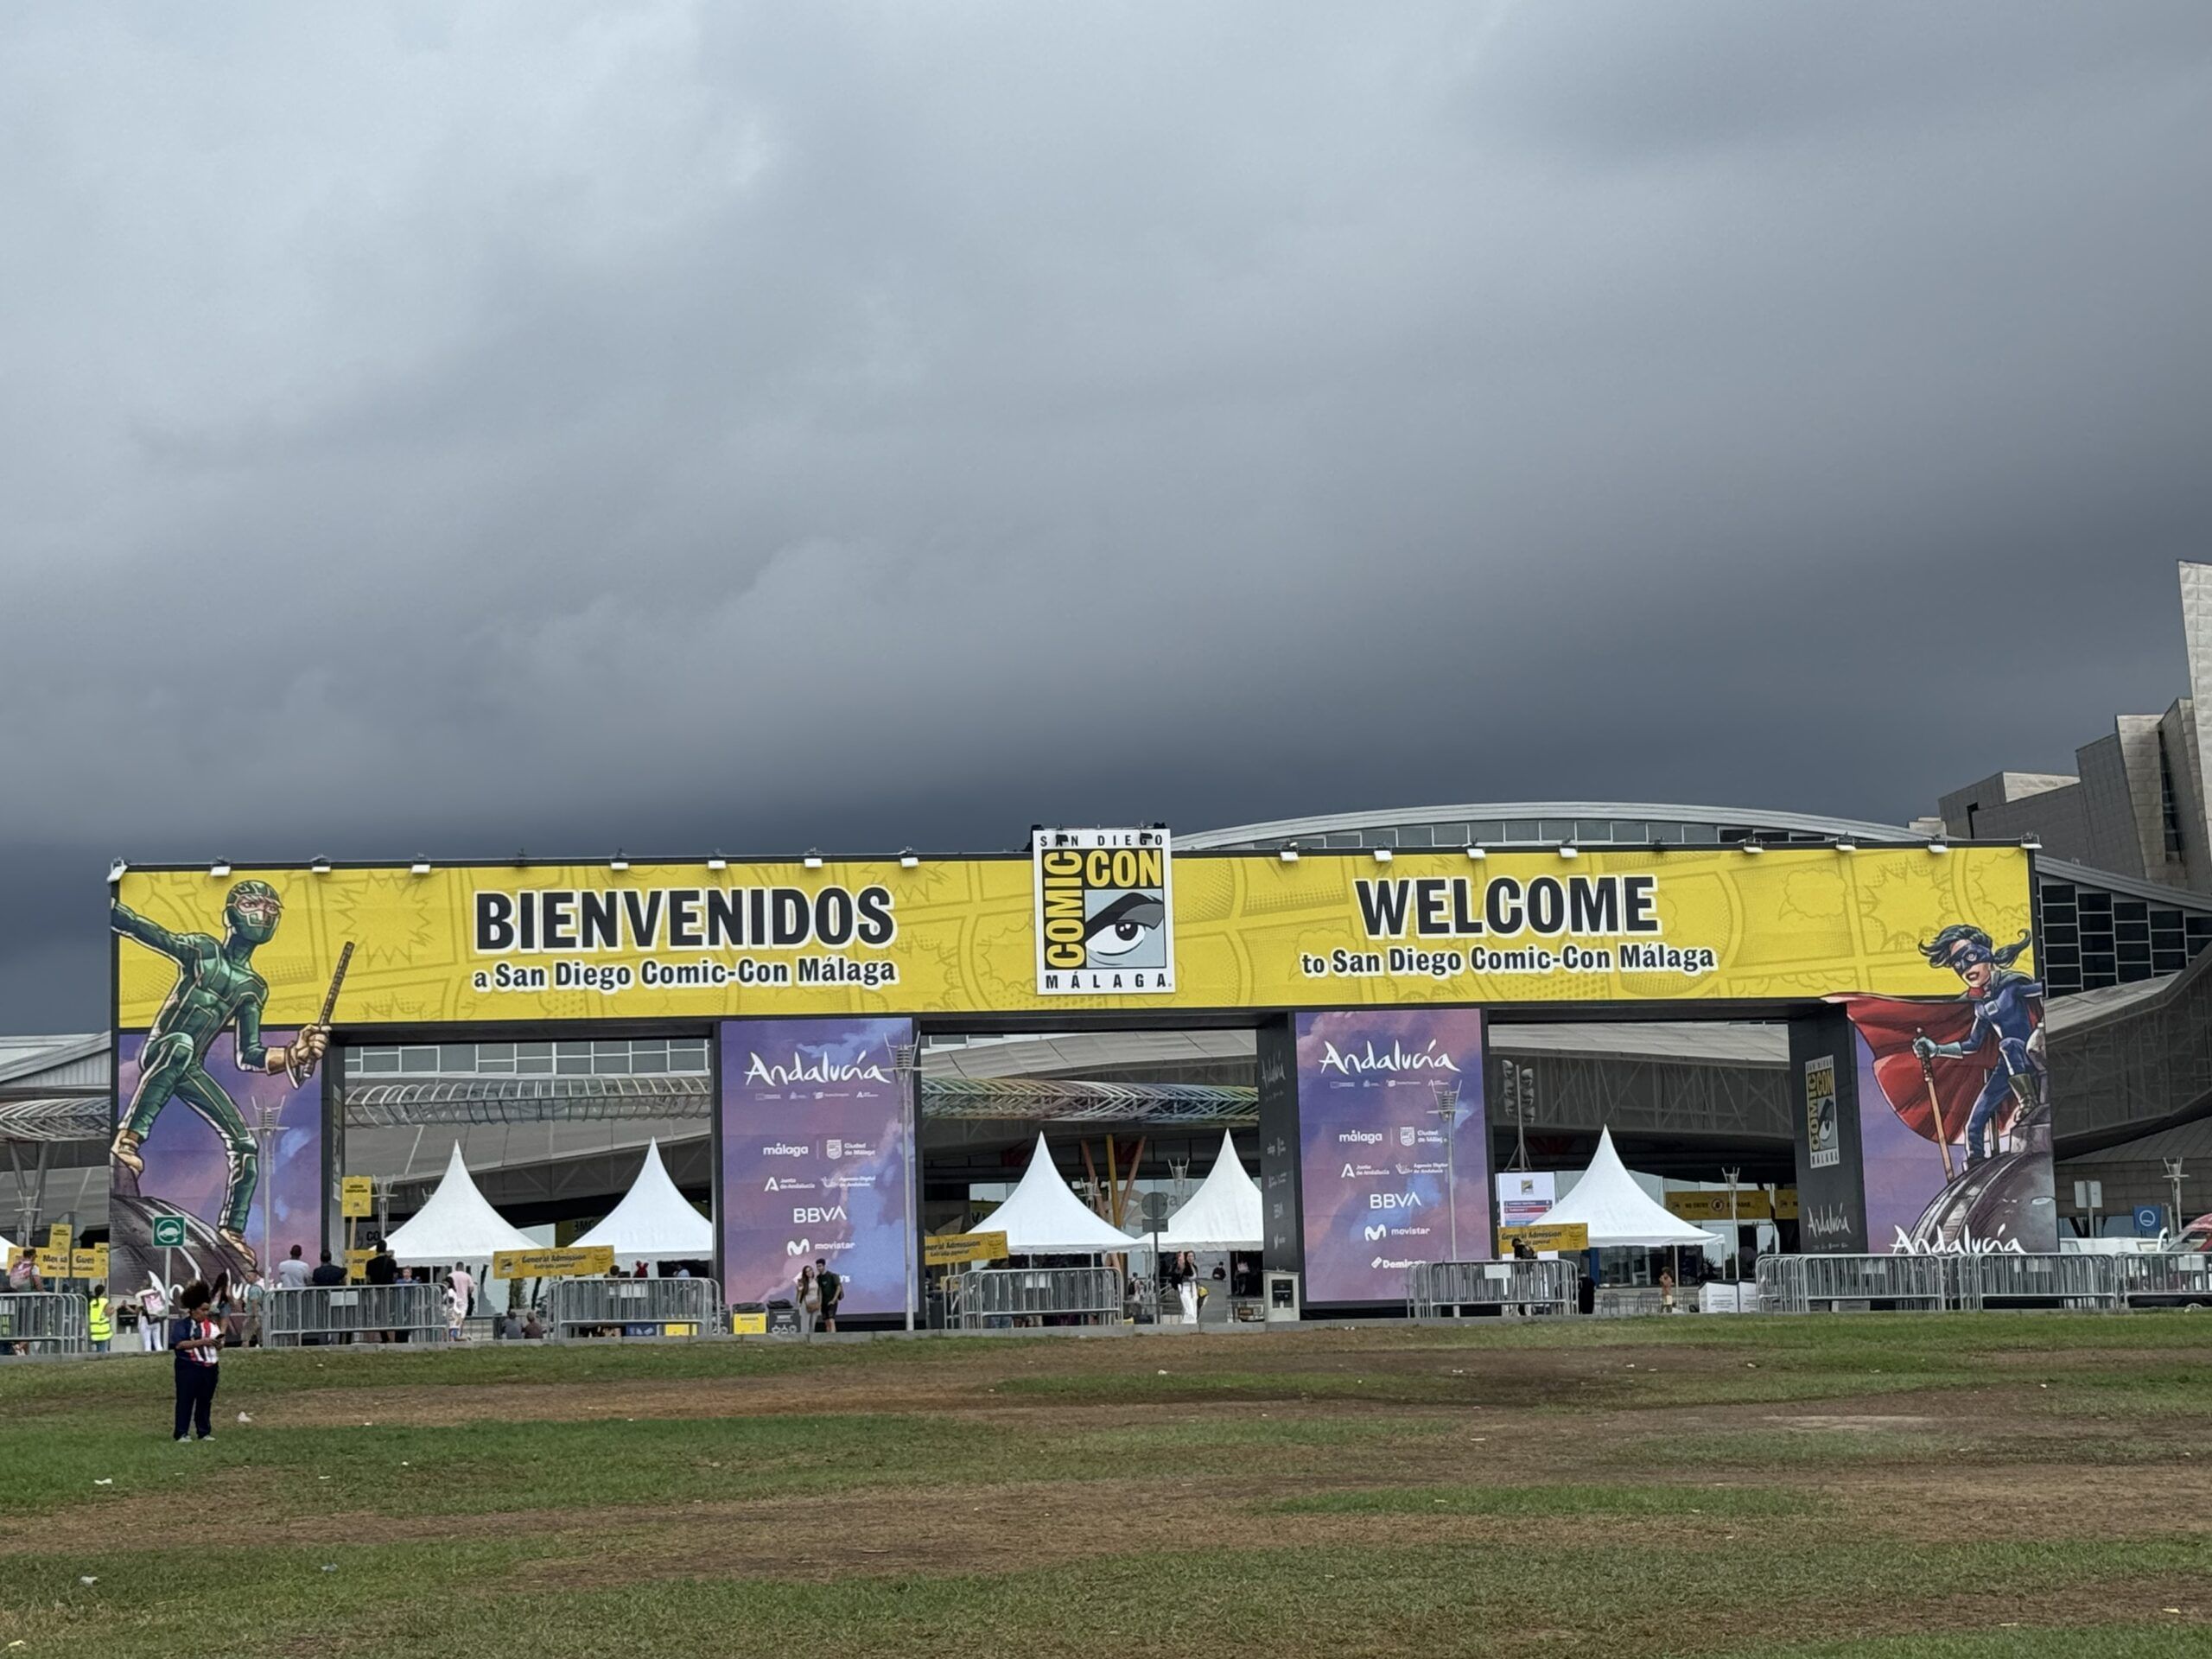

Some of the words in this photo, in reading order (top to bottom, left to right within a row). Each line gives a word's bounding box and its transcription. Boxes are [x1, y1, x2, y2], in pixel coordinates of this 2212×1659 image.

[1097, 834, 1162, 847] DIEGO
[1086, 849, 1162, 887] CON
[475, 887, 894, 950] BIENVENIDOS
[1044, 851, 1085, 968] COMIC
[1355, 876, 1659, 936] WELCOME
[474, 969, 487, 987] a
[495, 963, 544, 987] San
[555, 962, 631, 989] Diego
[641, 959, 787, 984] Comic-Con
[798, 957, 895, 986] Málaga
[1302, 953, 1325, 974] to
[1333, 950, 1380, 972] San
[1390, 947, 1461, 976] Diego
[1471, 945, 1610, 970] Comic-Con
[1620, 943, 1714, 973] Málaga
[1046, 971, 1166, 989] MÁLAGA
[744, 1050, 892, 1086] Andalucía
[1318, 1039, 1461, 1075] Andalucía
[1817, 1069, 1833, 1096] CON
[1808, 1072, 1820, 1150] COMIC
[763, 1142, 809, 1157] málaga
[1339, 1129, 1382, 1144] málaga
[793, 1205, 847, 1224] BBVA
[1370, 1192, 1421, 1209] BBVA
[815, 1241, 855, 1249] movistar
[1391, 1226, 1430, 1235] movistar
[1889, 1224, 2026, 1254] Andalucía
